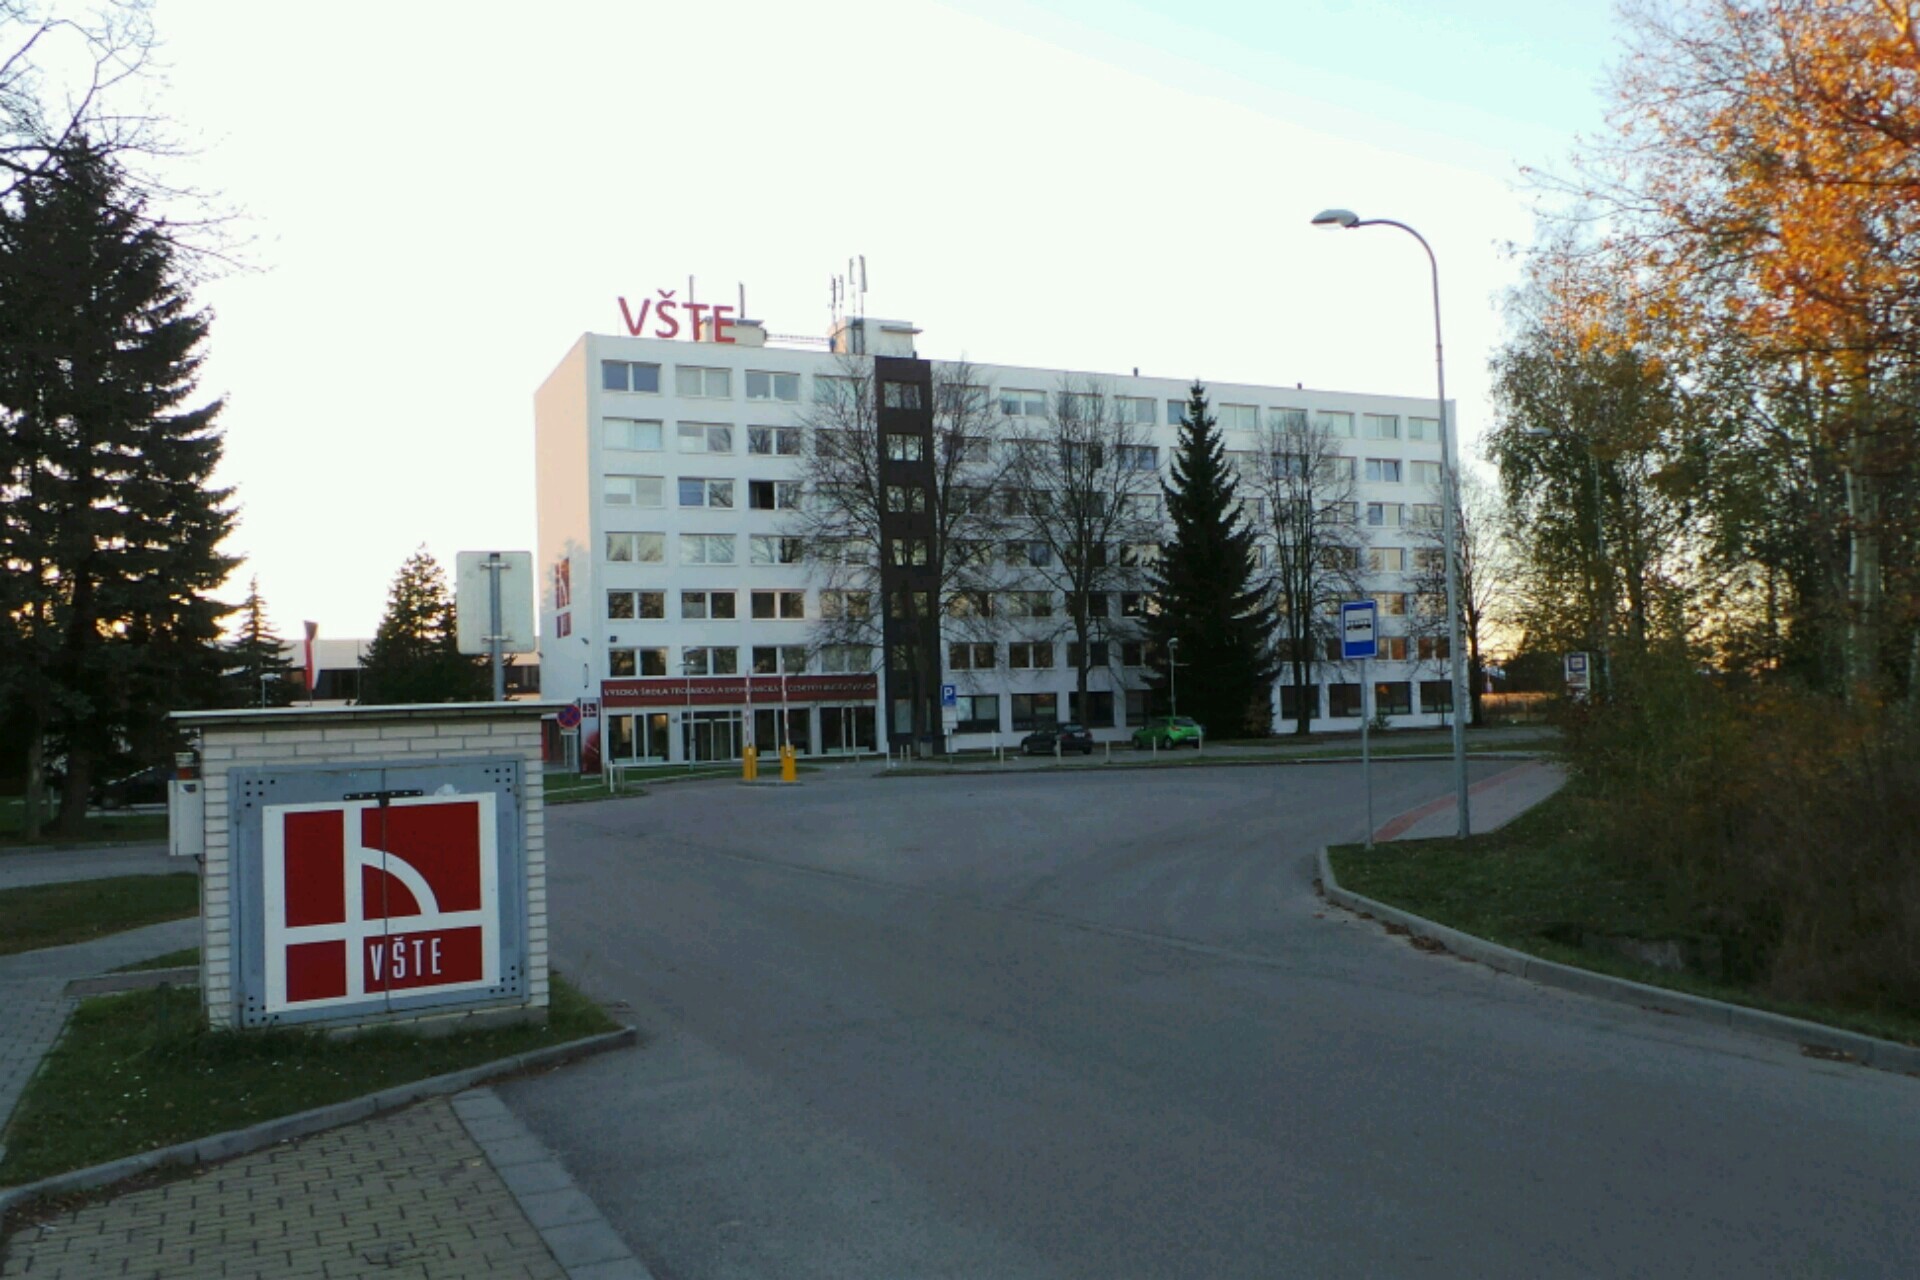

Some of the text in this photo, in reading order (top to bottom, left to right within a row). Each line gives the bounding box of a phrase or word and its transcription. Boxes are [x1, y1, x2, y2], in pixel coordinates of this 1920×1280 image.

[618, 289, 736, 343] VŠTE
[944, 687, 953, 700] P
[370, 936, 442, 981] VŠTE
